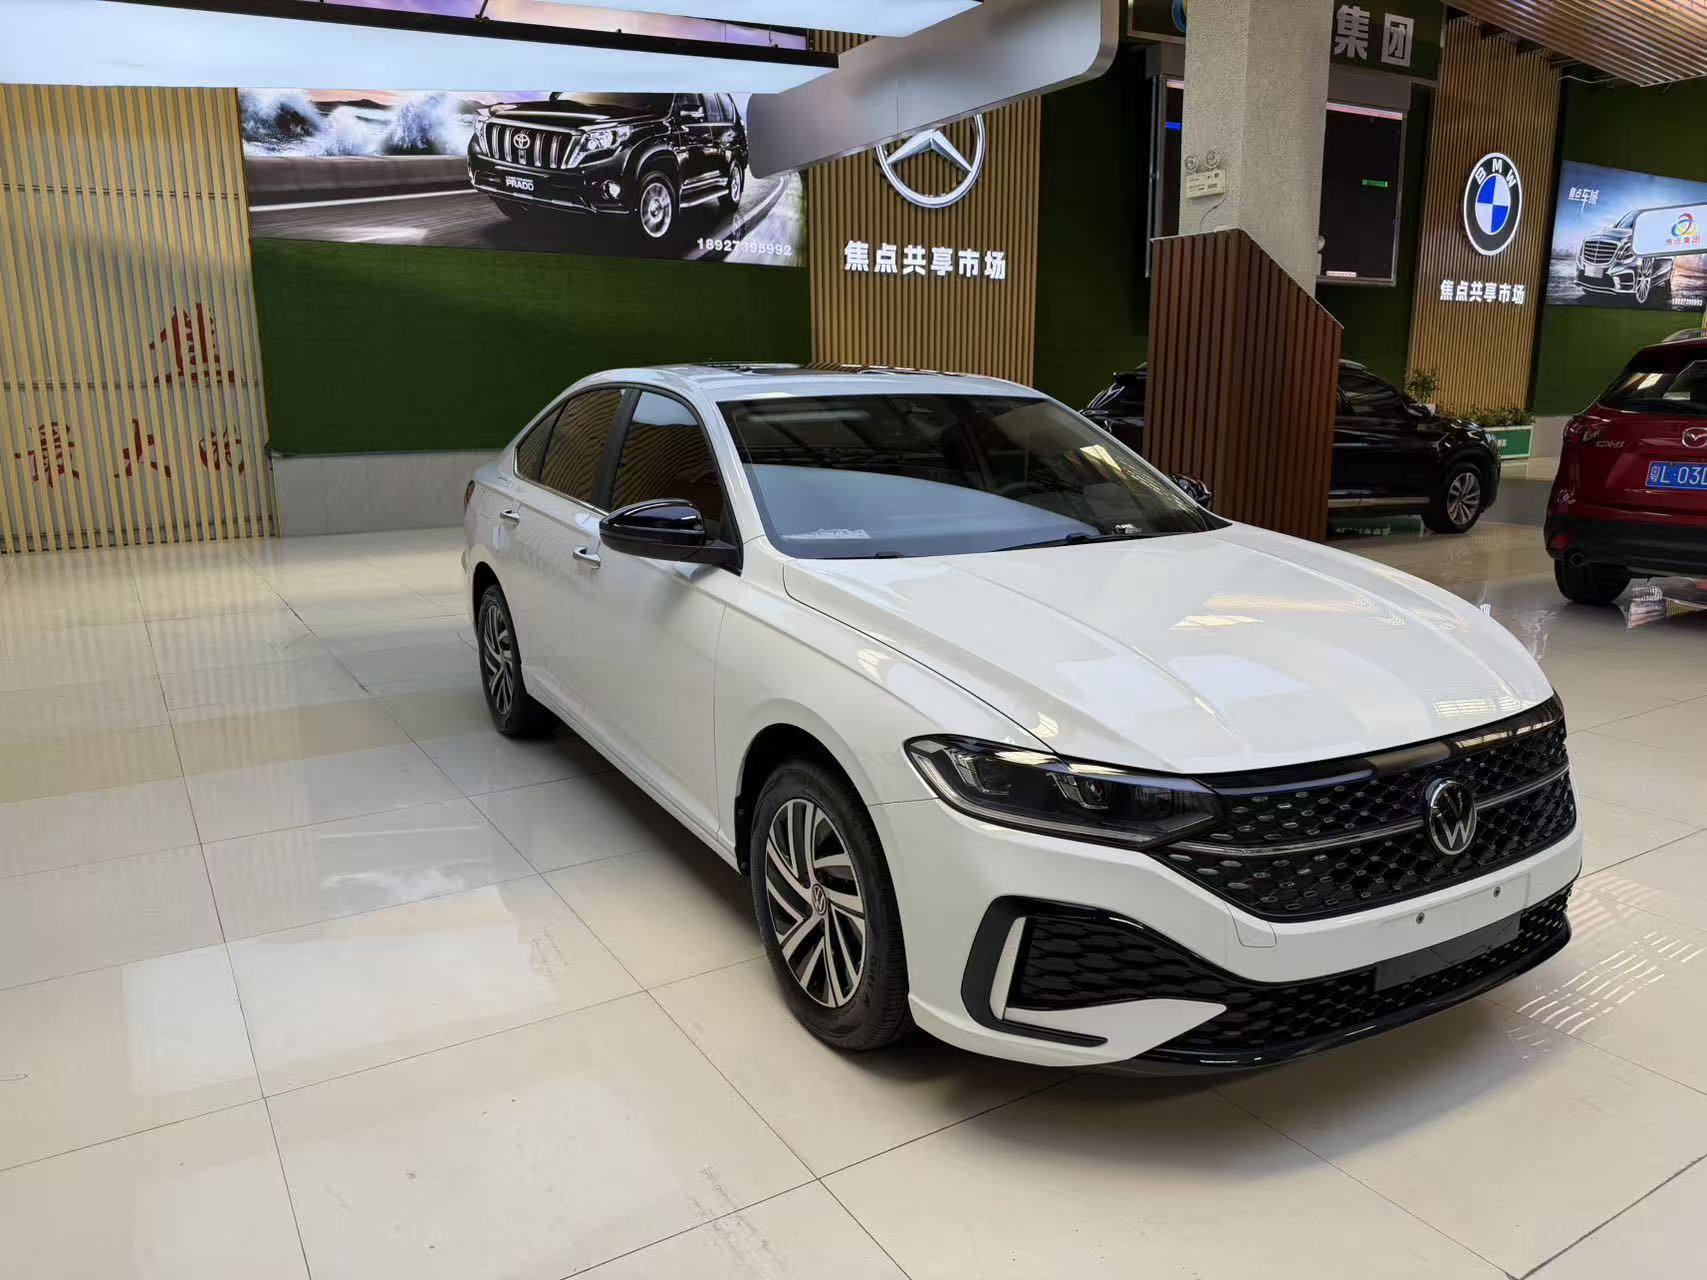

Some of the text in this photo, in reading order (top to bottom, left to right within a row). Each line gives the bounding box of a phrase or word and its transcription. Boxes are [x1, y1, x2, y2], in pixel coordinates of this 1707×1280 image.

[1334, 4, 1414, 67] 集团
[506, 179, 535, 191] PRADO
[1475, 158, 1517, 188] BMW
[697, 238, 793, 256] 18927395992
[844, 240, 1006, 280] 焦点共享市场
[1440, 279, 1526, 305] 焦点共享市场
